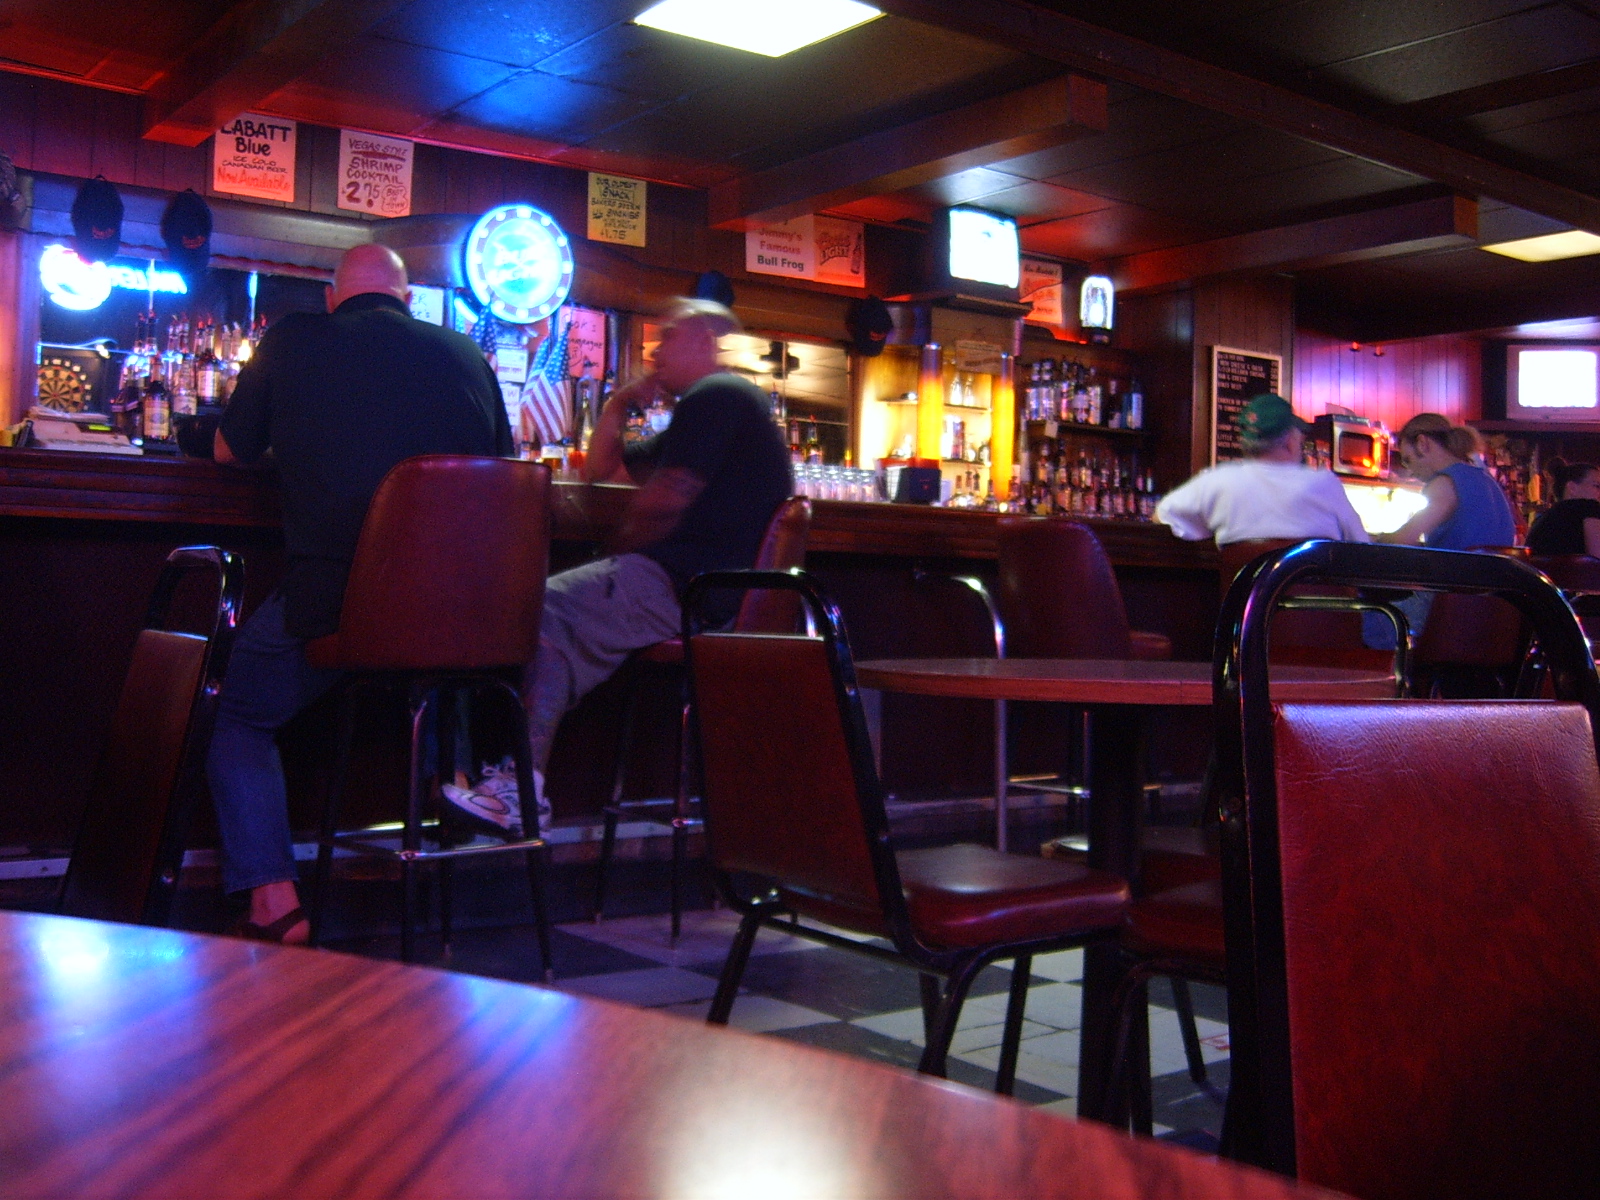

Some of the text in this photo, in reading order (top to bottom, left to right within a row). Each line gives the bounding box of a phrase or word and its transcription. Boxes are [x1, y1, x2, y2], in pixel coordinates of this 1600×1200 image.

[221, 119, 292, 142] LABATT
[235, 136, 272, 156] Blue
[348, 138, 382, 151] VEGAS
[348, 156, 403, 174] SHRIMP
[346, 167, 404, 185] COCKTAIL
[760, 228, 803, 242] Jimmy's
[760, 240, 801, 255] Famous
[757, 255, 804, 272] Bull Frog
